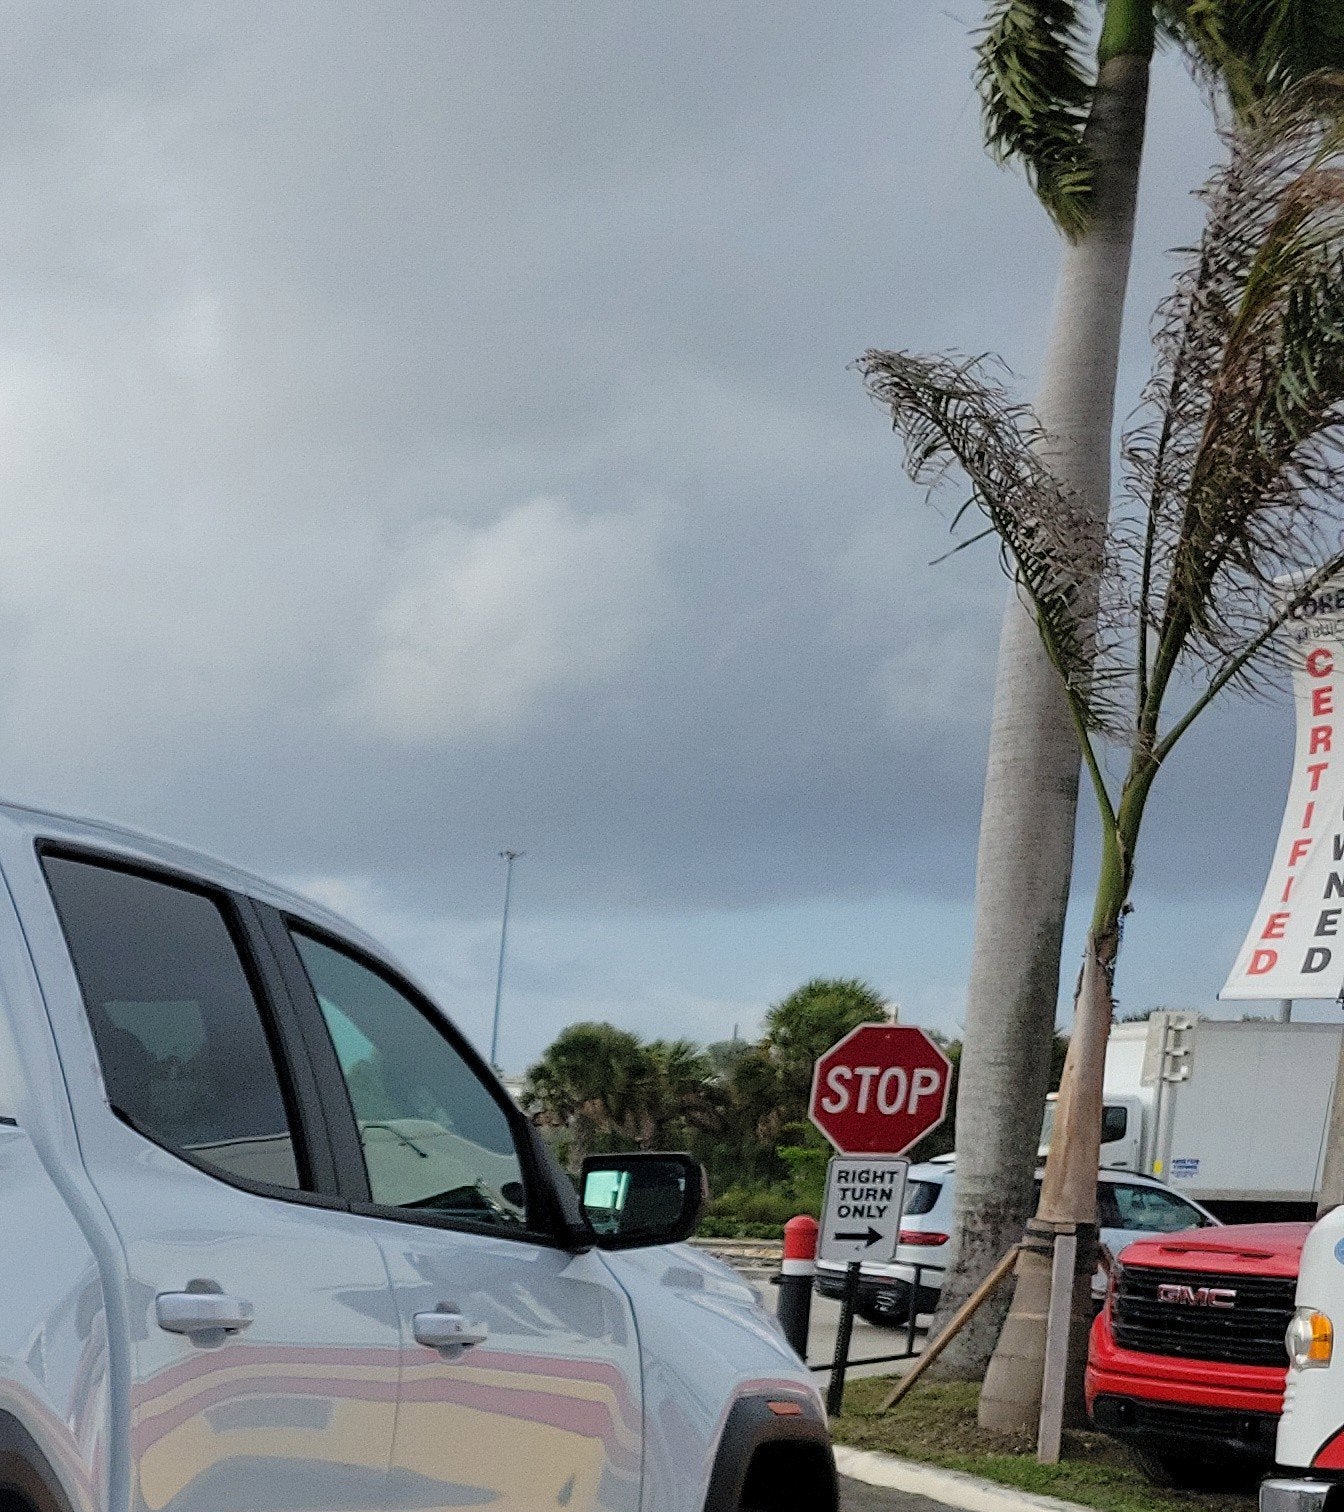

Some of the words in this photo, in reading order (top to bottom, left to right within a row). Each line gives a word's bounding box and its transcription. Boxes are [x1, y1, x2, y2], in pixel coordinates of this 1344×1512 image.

[1246, 647, 1334, 976] CERTIFIED
[820, 1064, 941, 1116] STOP
[836, 1169, 899, 1185] RIGHT
[839, 1186, 894, 1202] TURN
[837, 1205, 889, 1219] ONLY
[1157, 1283, 1237, 1309] GMC
